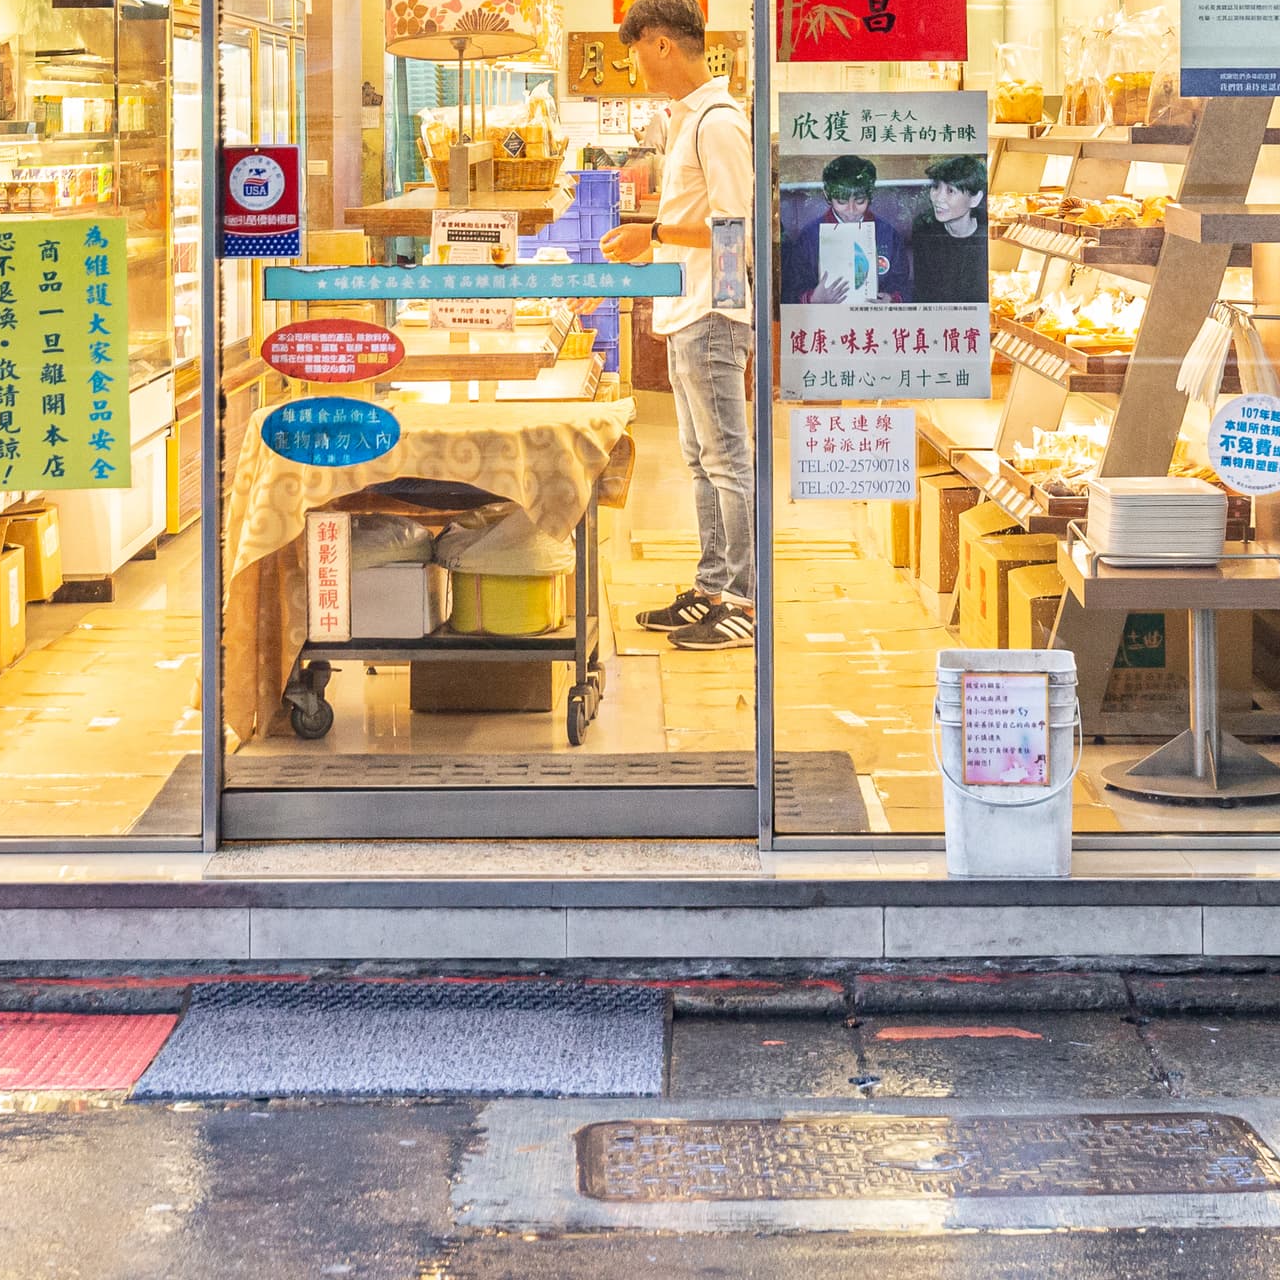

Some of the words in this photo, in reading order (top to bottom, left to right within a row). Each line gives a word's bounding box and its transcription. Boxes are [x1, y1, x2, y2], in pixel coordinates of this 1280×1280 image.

[861, 109, 918, 122] 第一夫人
[792, 110, 851, 142] 欣獲
[860, 124, 976, 142] 周美青的青睞
[246, 187, 267, 195] USA
[790, 330, 828, 354] 健康
[840, 329, 879, 354] 味美
[893, 328, 930, 354] 貨真
[943, 329, 981, 354] 價實
[38, 240, 68, 477] 商品一旦離開本店
[84, 224, 116, 479] 為維護大家食品安全
[806, 414, 893, 432] 警民連線
[806, 438, 890, 453] 中崙派出所
[798, 459, 910, 473] TEL:02-25790718
[799, 480, 911, 495] TEL:02-25790720
[318, 521, 339, 633] 錄影監視中
